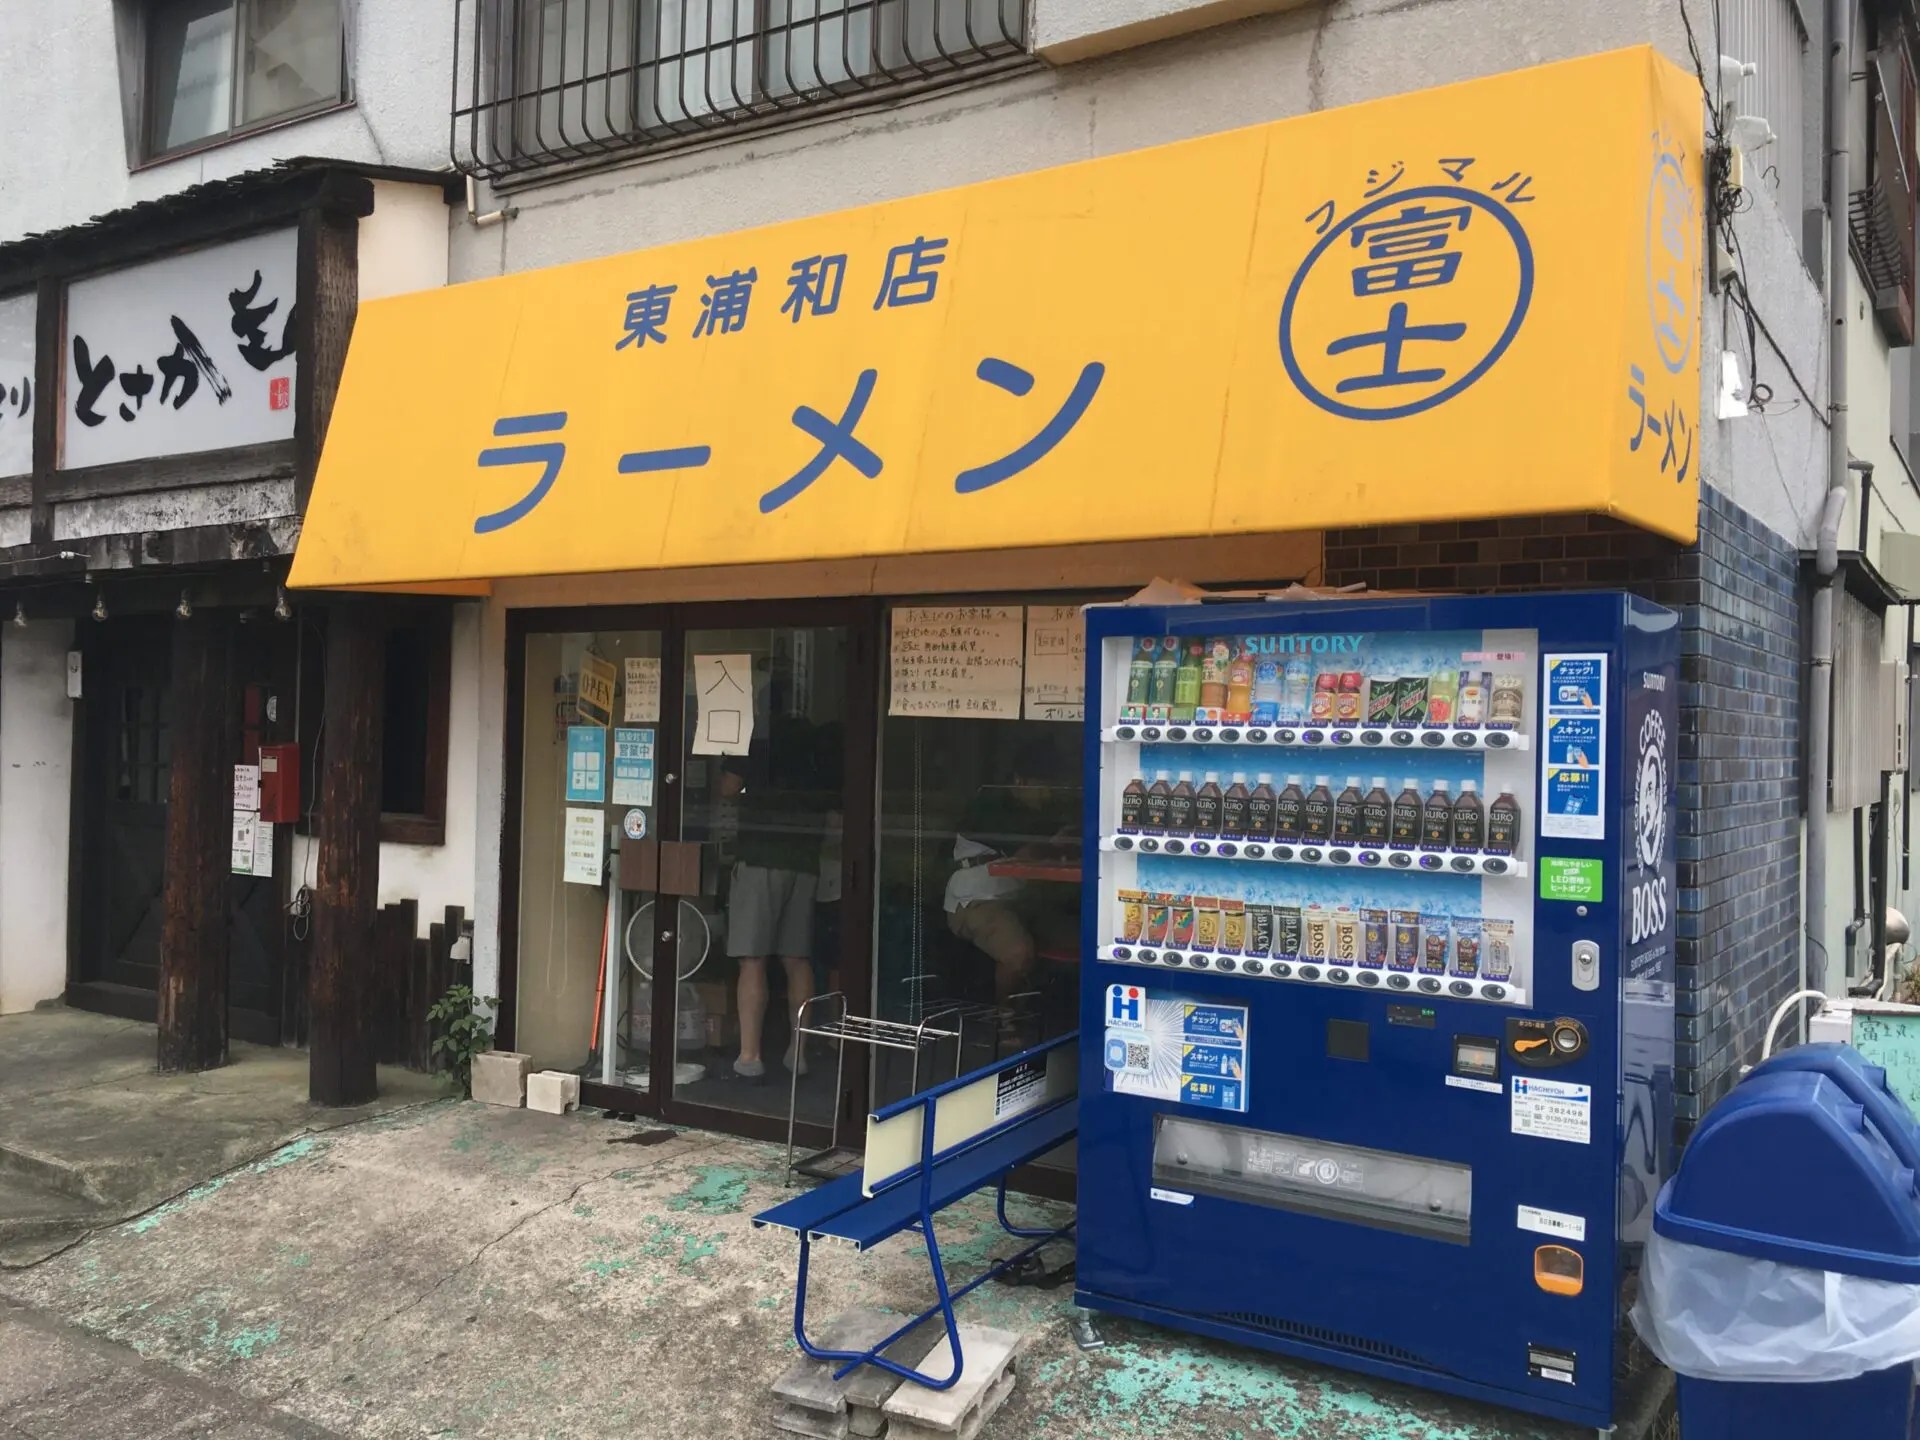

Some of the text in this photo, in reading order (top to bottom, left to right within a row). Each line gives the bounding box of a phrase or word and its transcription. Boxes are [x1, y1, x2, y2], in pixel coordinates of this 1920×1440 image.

[1304, 157, 1536, 235] フジマル
[614, 235, 949, 351] 東浦和店
[1325, 205, 1473, 394] 富士
[1628, 362, 1692, 485] ラーメン
[473, 357, 1106, 535] ラーメン
[581, 672, 612, 706] OPEN
[705, 660, 745, 745] 入口
[1640, 708, 1666, 755] COFFEE
[619, 743, 650, 758] 営業中
[1148, 798, 1168, 807] KURO
[1171, 800, 1190, 809] KURO
[1196, 801, 1216, 810] KURO
[1224, 802, 1243, 811] KURO
[1250, 803, 1270, 812] KURO
[1278, 803, 1299, 813] KURO
[1305, 805, 1328, 815] KURO
[1336, 806, 1357, 816] KURO
[1364, 807, 1387, 817] KURO
[1394, 808, 1417, 818] KURO
[1425, 810, 1449, 819] KURO
[1454, 811, 1478, 821] KURO
[1490, 812, 1513, 822] KURO
[1632, 876, 1667, 944] BOSS
[1257, 915, 1270, 951] BLACK
[1286, 917, 1299, 955] BLACK
[1313, 923, 1325, 957] BOSS
[1342, 926, 1354, 960] BOSS
